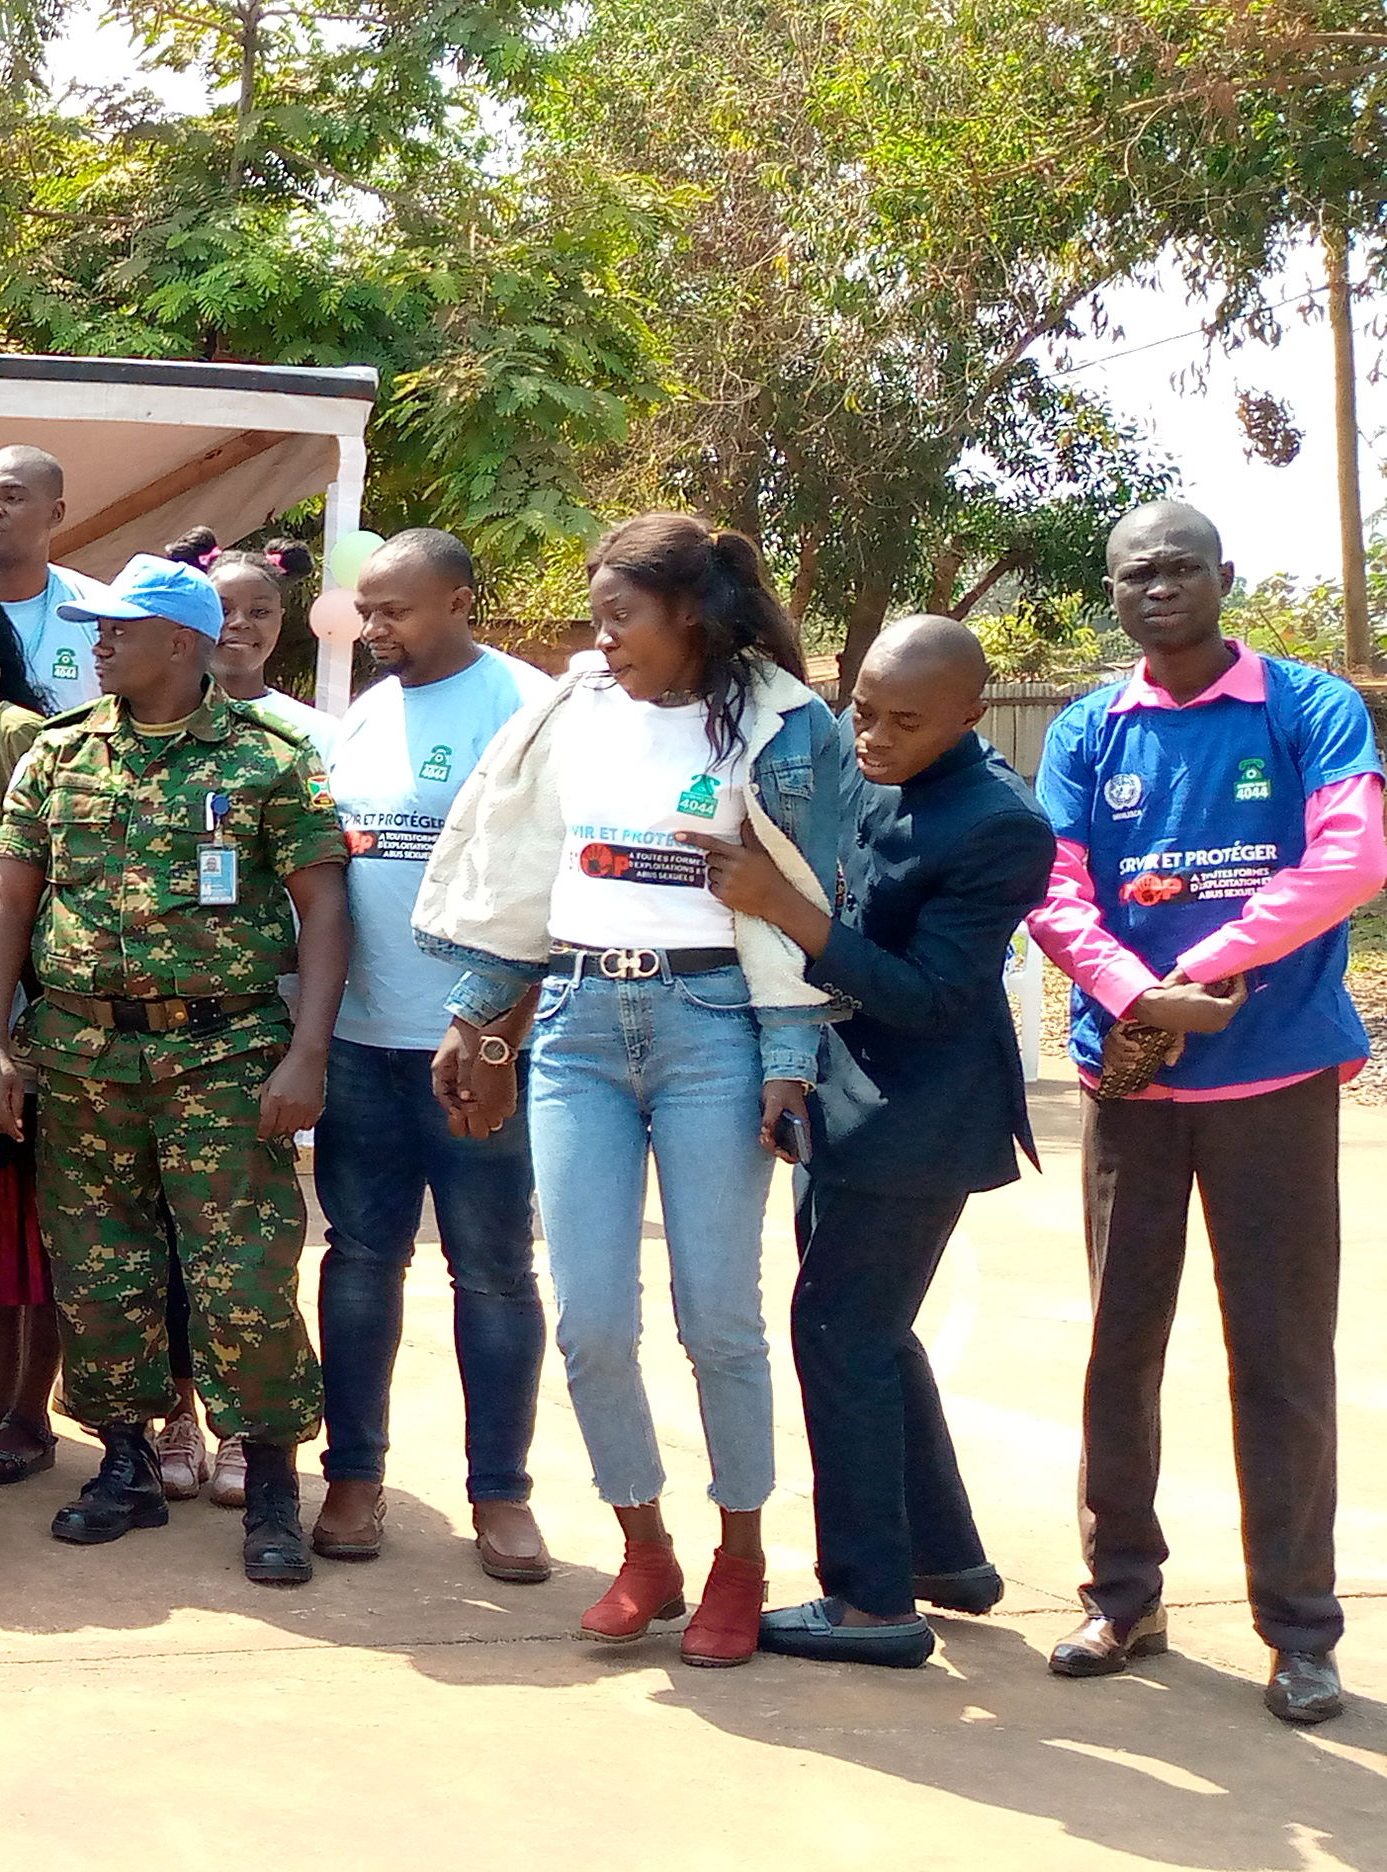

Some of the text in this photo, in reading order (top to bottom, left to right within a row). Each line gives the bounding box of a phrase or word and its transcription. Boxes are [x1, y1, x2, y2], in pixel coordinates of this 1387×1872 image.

[1236, 786, 1269, 801] 4044
[679, 798, 715, 815] 4044
[363, 813, 377, 827] ET
[599, 826, 618, 841] ET
[1161, 851, 1184, 869] ET
[1184, 839, 1278, 868] PROTÉGER
